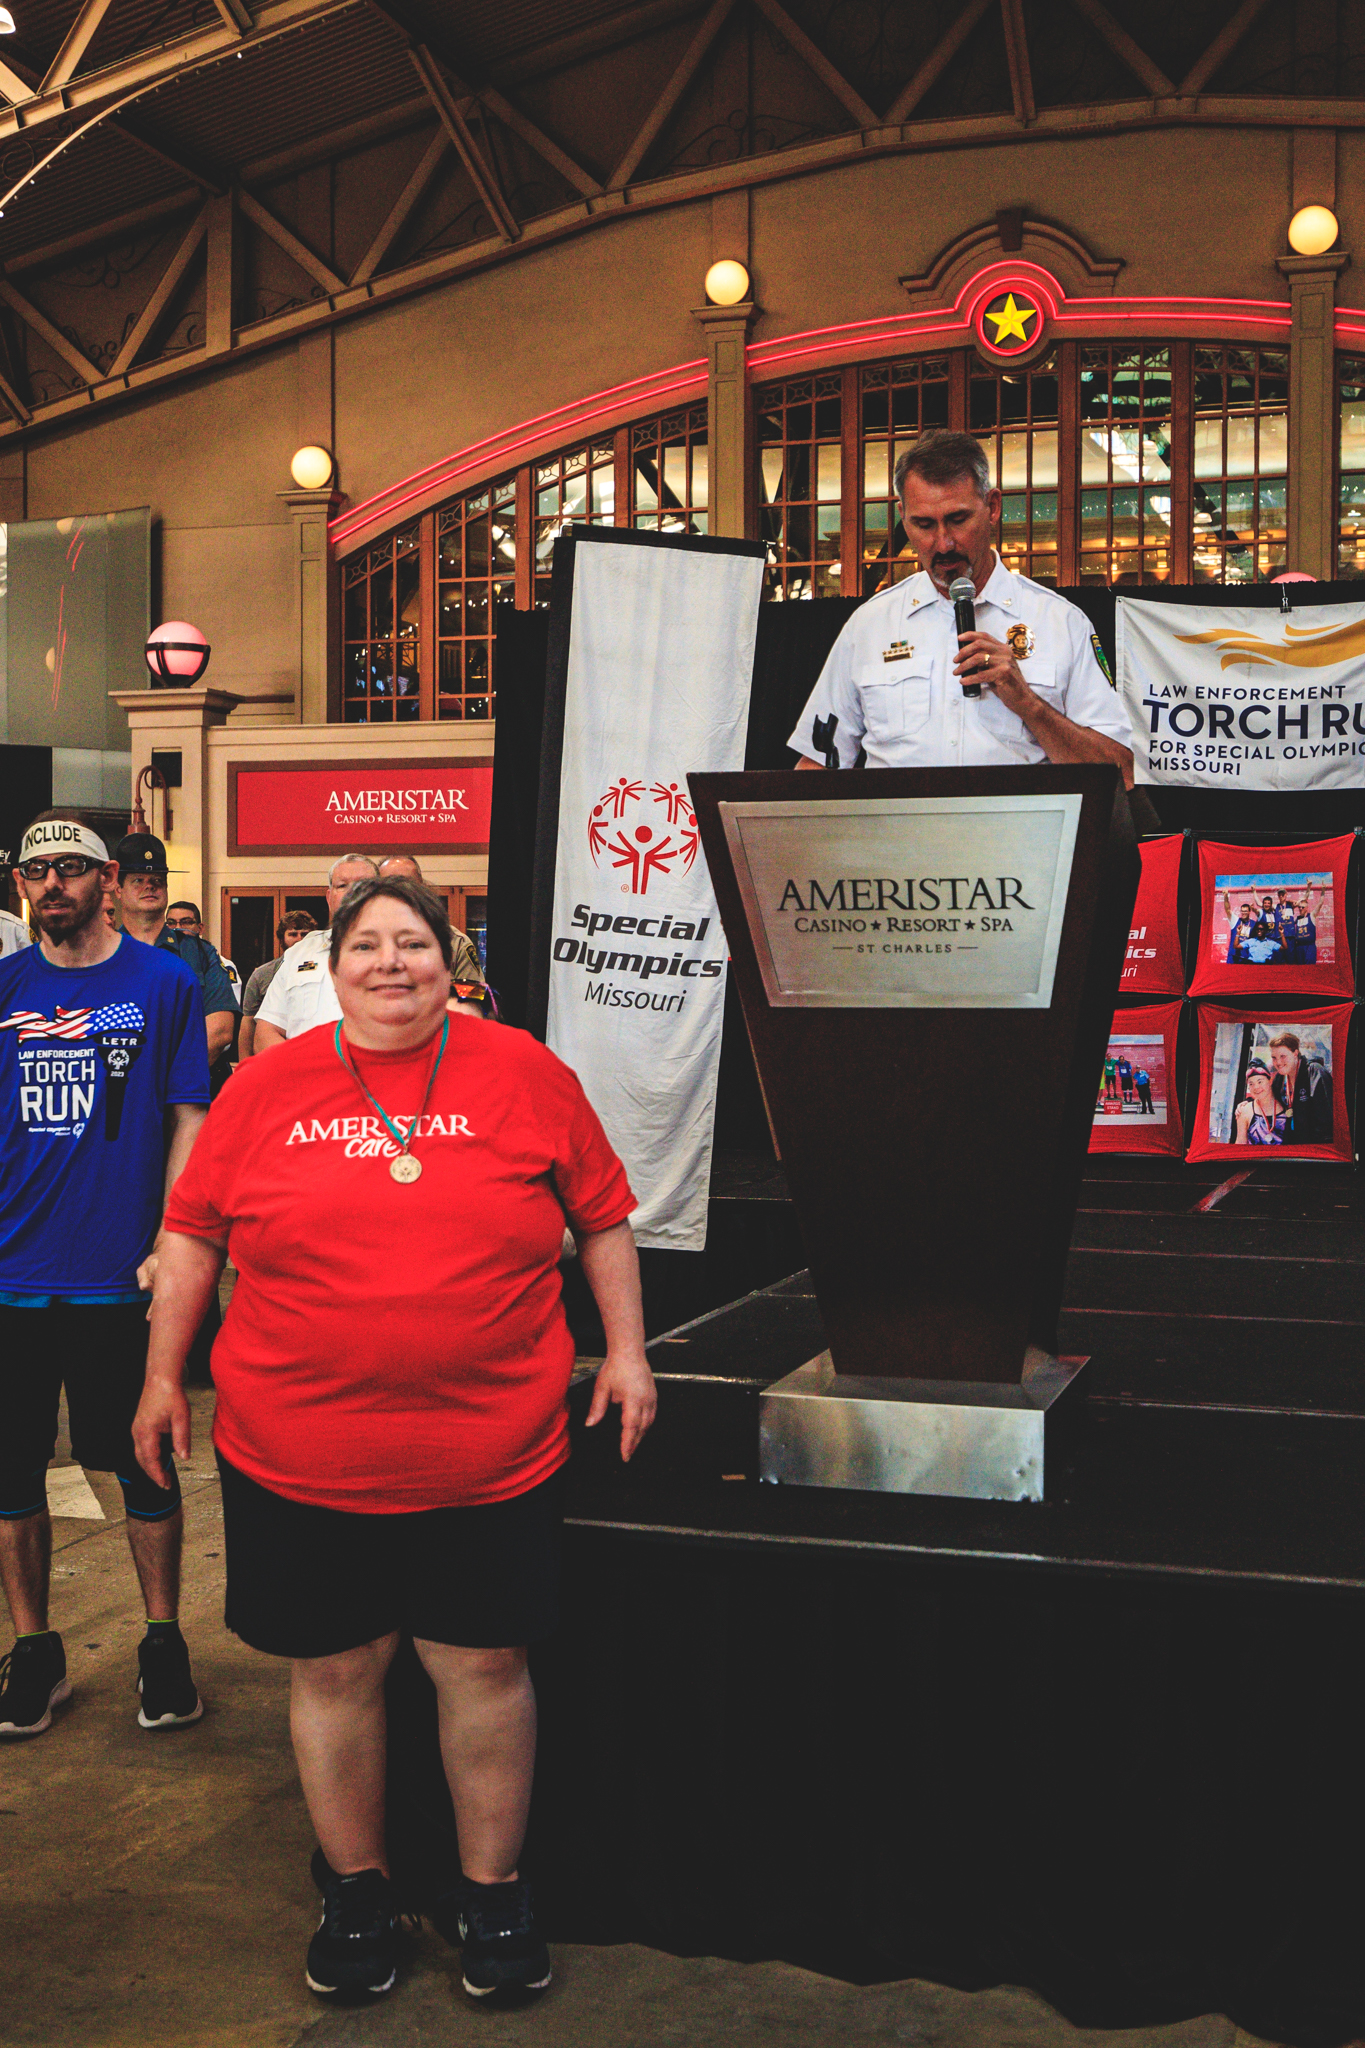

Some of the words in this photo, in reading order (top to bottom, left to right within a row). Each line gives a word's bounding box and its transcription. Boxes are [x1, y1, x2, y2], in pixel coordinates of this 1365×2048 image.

[1149, 684, 1188, 698] LAW
[1195, 685, 1346, 700] ENFORCEMENT
[1142, 699, 1309, 739] TORCH
[1149, 740, 1186, 755] FOR
[1194, 744, 1275, 760] SPECIAL
[1149, 757, 1241, 776] MISSOURI
[325, 789, 469, 812] AMERISTAR
[777, 877, 1036, 911] AMERISTAR
[571, 903, 711, 941] Special
[553, 937, 723, 980] Olympics
[882, 943, 953, 954] CHARLES
[584, 980, 687, 1013] Missouri
[102, 1036, 138, 1046] LETR
[18, 1050, 35, 1060] LAW
[36, 1048, 95, 1059] ENFORCEMENT
[19, 1060, 95, 1083] TORCH
[20, 1083, 95, 1122] RUN
[285, 1113, 477, 1146] AMERSTAR
